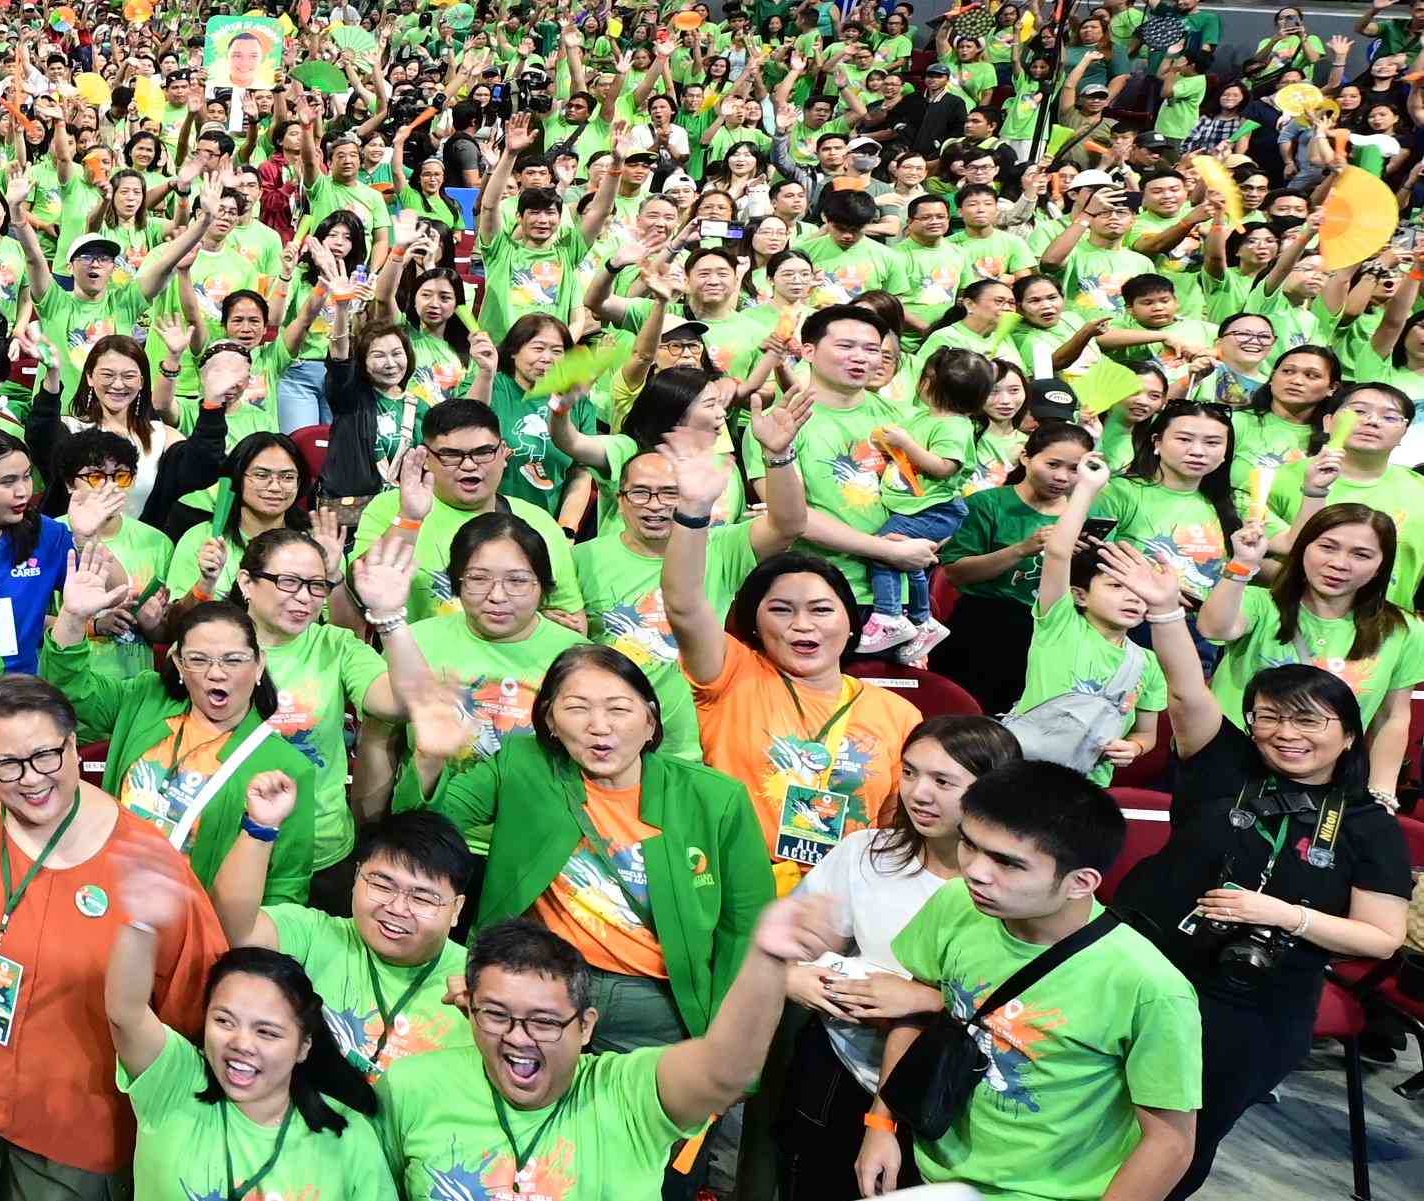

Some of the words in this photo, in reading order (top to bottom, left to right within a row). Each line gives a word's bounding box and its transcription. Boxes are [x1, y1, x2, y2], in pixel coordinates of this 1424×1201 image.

[10, 567, 41, 578] CARES
[1319, 810, 1339, 842] Nikon
[797, 839, 818, 854] ALL
[783, 846, 824, 864] ACCES
